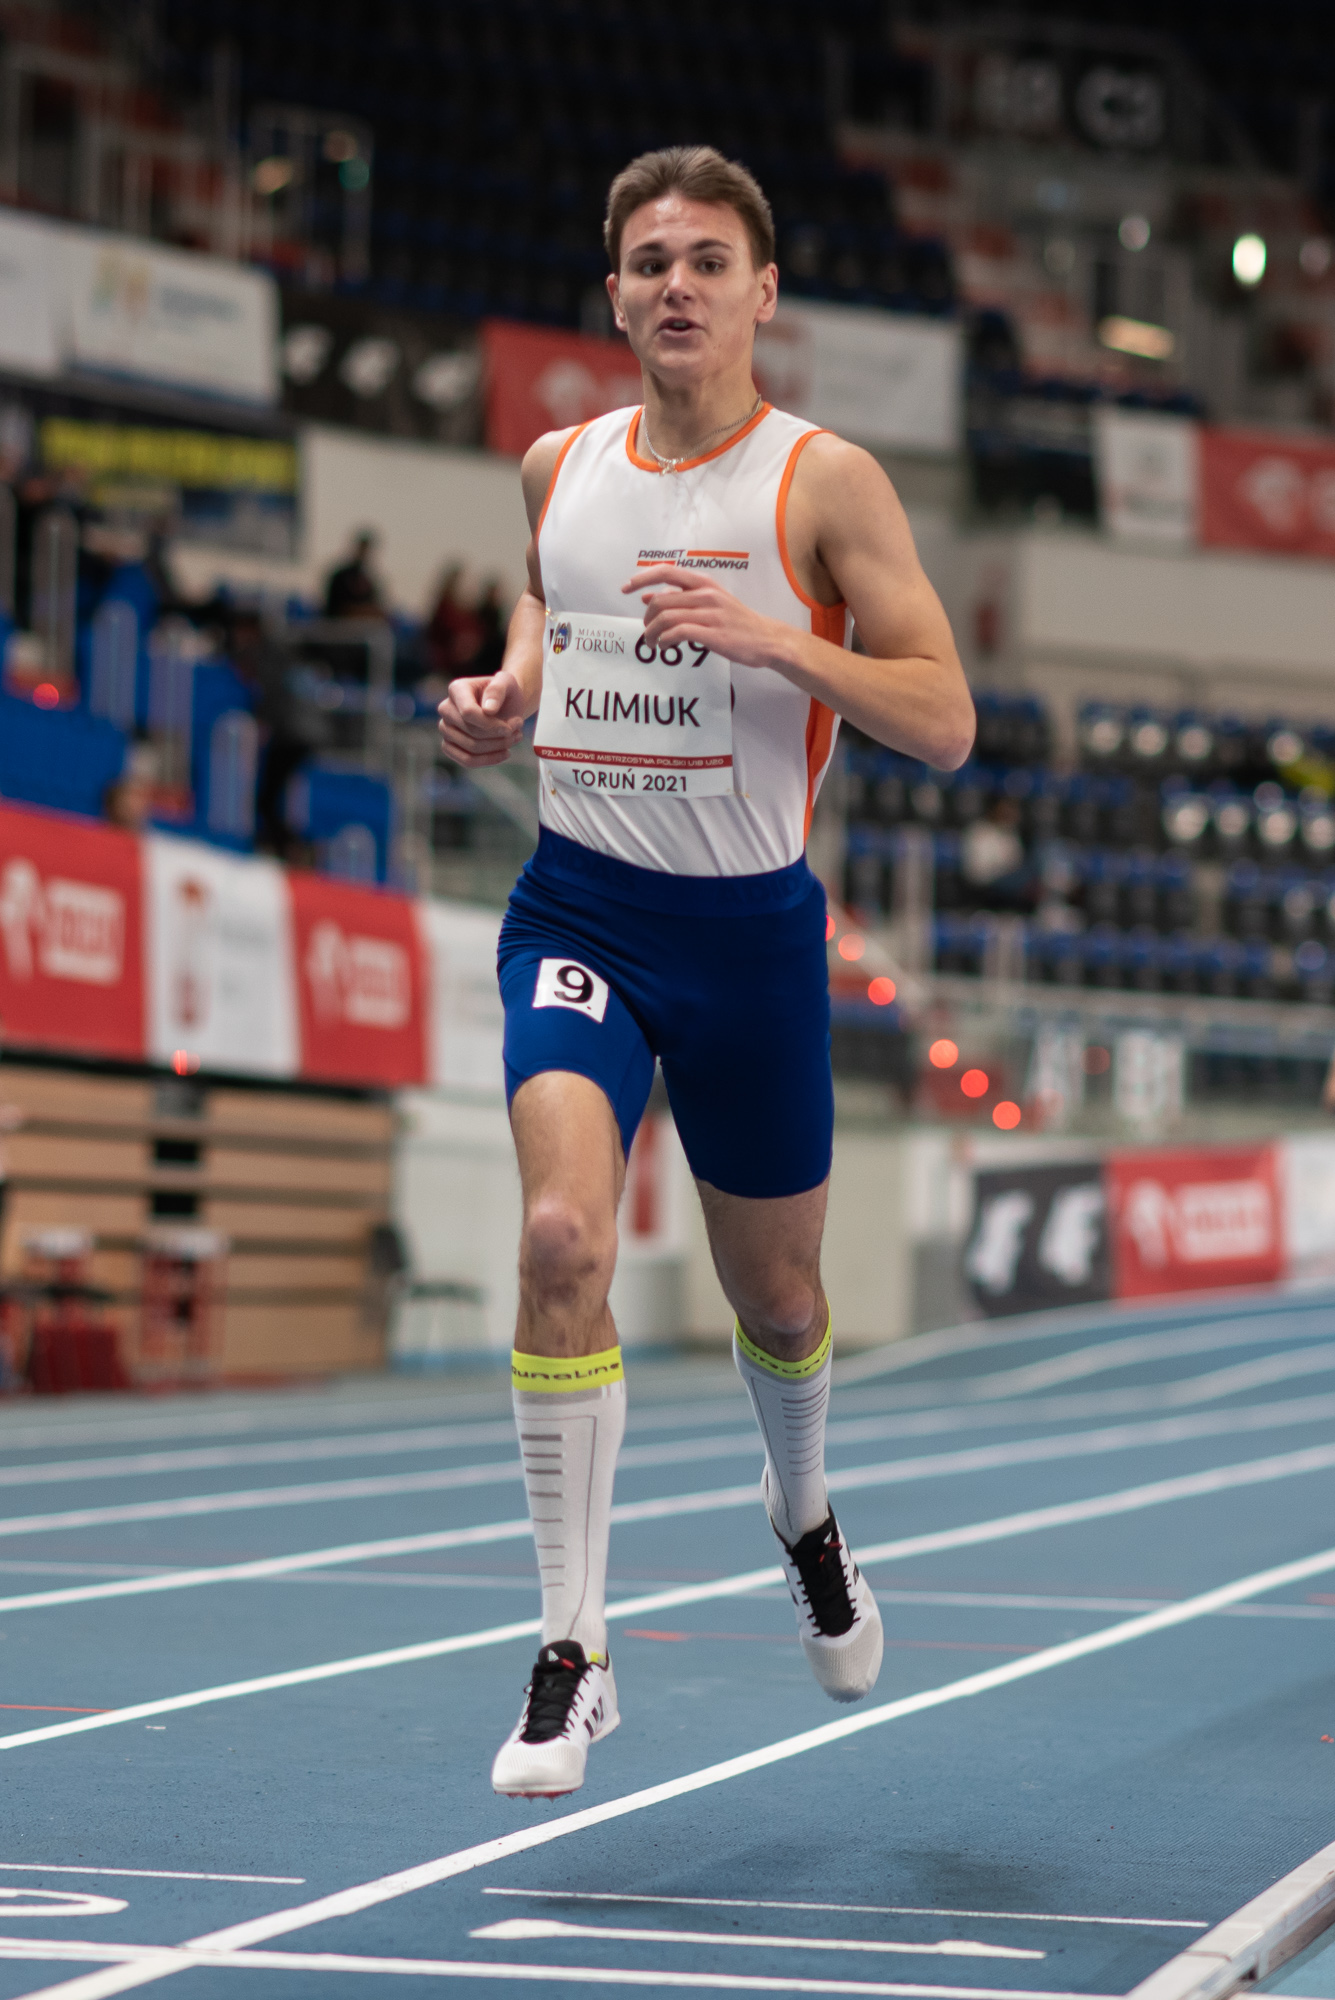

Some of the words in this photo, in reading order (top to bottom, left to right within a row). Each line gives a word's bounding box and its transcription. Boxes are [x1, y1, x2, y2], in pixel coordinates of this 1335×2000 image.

[638, 549, 685, 559] PARKIET
[676, 558, 749, 570] HAJNÓWKA
[578, 628, 615, 638] MIASTO
[575, 636, 625, 654] TORUŃ
[565, 687, 701, 727] KLIMIUK
[541, 749, 562, 758] PZLA
[563, 751, 595, 760] HALOWE
[597, 754, 655, 765] MISTRZOSTWA
[656, 758, 687, 766] POLSKI
[572, 768, 635, 790] TORUŃ
[642, 774, 687, 792] 2021
[553, 965, 594, 1004] 9
